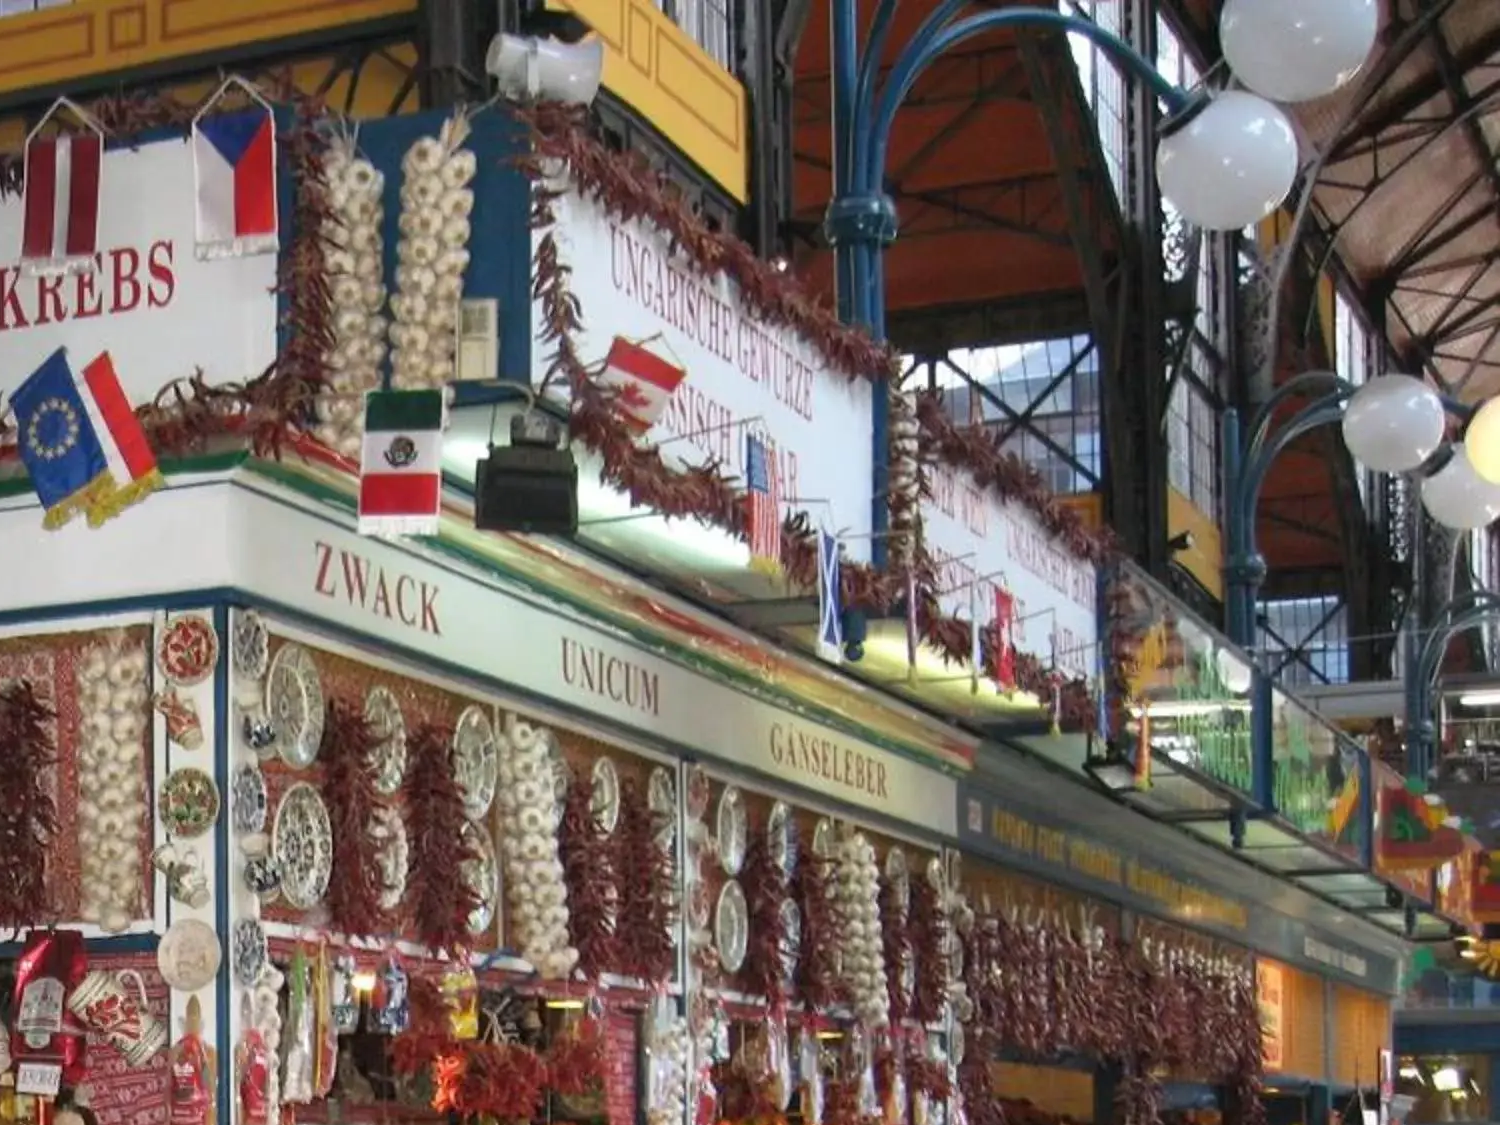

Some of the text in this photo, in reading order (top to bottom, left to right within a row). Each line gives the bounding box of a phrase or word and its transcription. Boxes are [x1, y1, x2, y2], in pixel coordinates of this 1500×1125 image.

[610, 222, 732, 363] UNGARISCHE
[660, 382, 732, 466] SSISCH
[314, 540, 660, 716] ZWACK UNICUM
